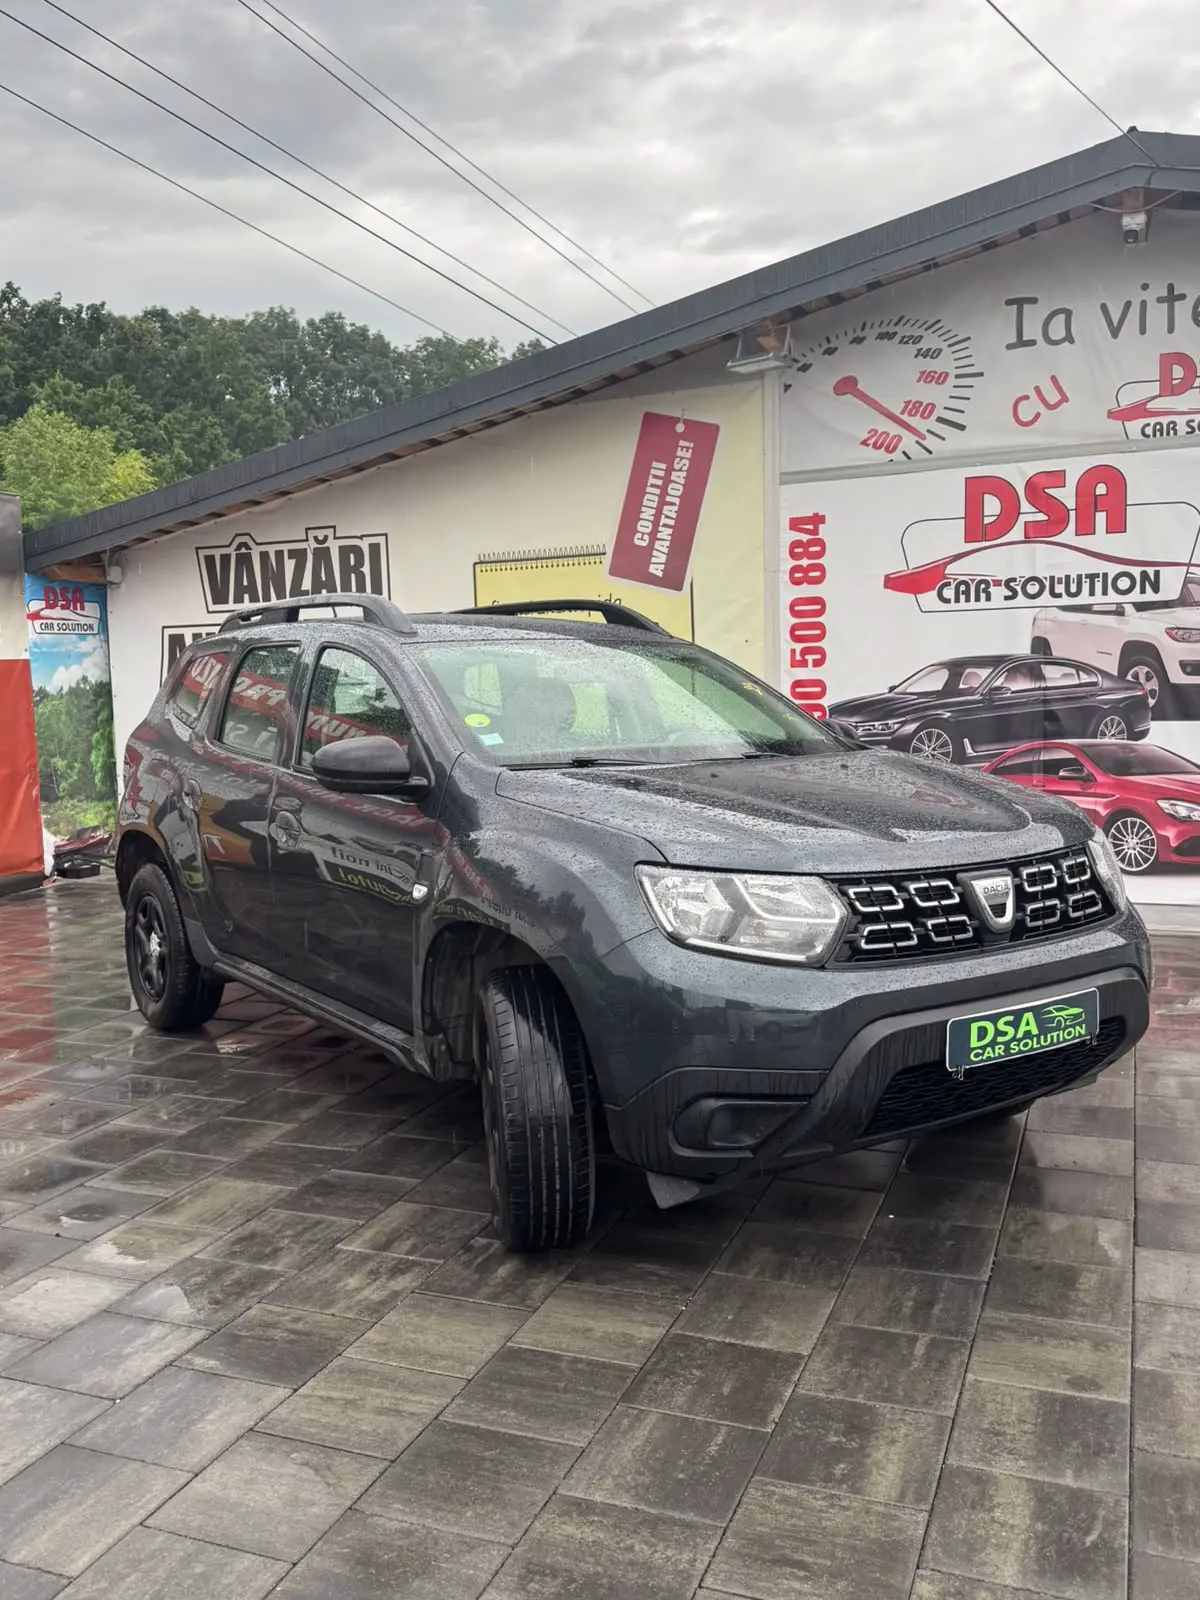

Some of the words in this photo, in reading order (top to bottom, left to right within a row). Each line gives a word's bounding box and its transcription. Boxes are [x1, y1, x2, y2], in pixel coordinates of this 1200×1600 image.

[898, 334, 925, 346] 120
[1005, 296, 1076, 351] Ia
[914, 347, 943, 360] 140
[916, 370, 950, 386] 160
[899, 399, 937, 420] 180
[1012, 375, 1070, 428] cu
[859, 428, 903, 454] 200
[1140, 421, 1178, 439] CAR
[633, 461, 668, 547] CONDITII
[648, 439, 695, 578] AVANTAJOASE!
[964, 464, 1127, 544] DSA
[788, 512, 826, 587] 884
[203, 534, 384, 605] VÂNZĂRI
[936, 578, 992, 604] CAR
[1003, 569, 1161, 601] SOLUTION
[44, 586, 85, 611] DSA
[40, 622, 55, 632] CAR
[57, 622, 94, 632] SOLUTION
[789, 596, 827, 669] 500
[970, 1012, 1040, 1048] DSA
[970, 1044, 1005, 1062] CAR
[1010, 1023, 1087, 1054] SOLUTION
